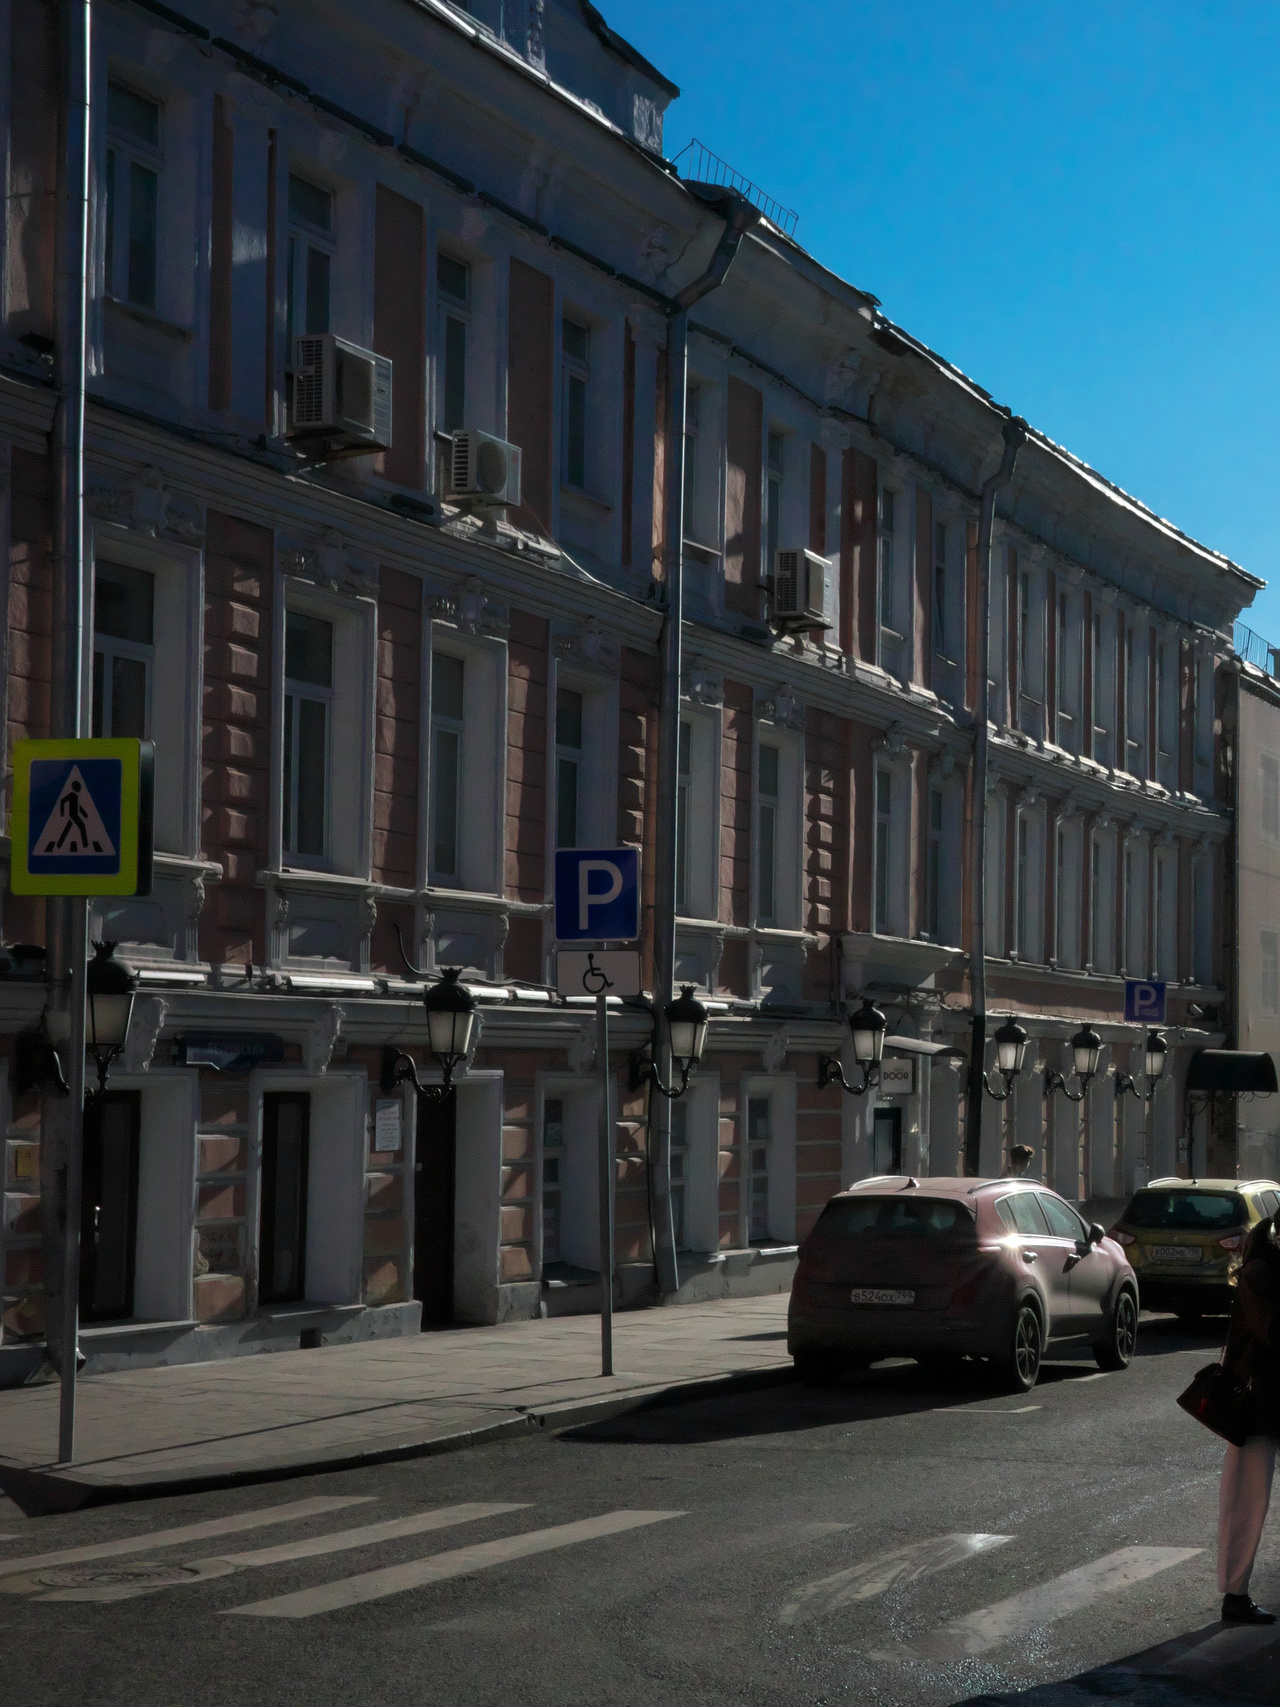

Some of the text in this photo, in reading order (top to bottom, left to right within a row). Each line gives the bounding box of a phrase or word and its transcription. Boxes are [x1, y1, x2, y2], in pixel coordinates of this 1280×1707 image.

[578, 859, 624, 931] P
[1134, 984, 1158, 1017] P
[883, 1071, 909, 1081] DOOR
